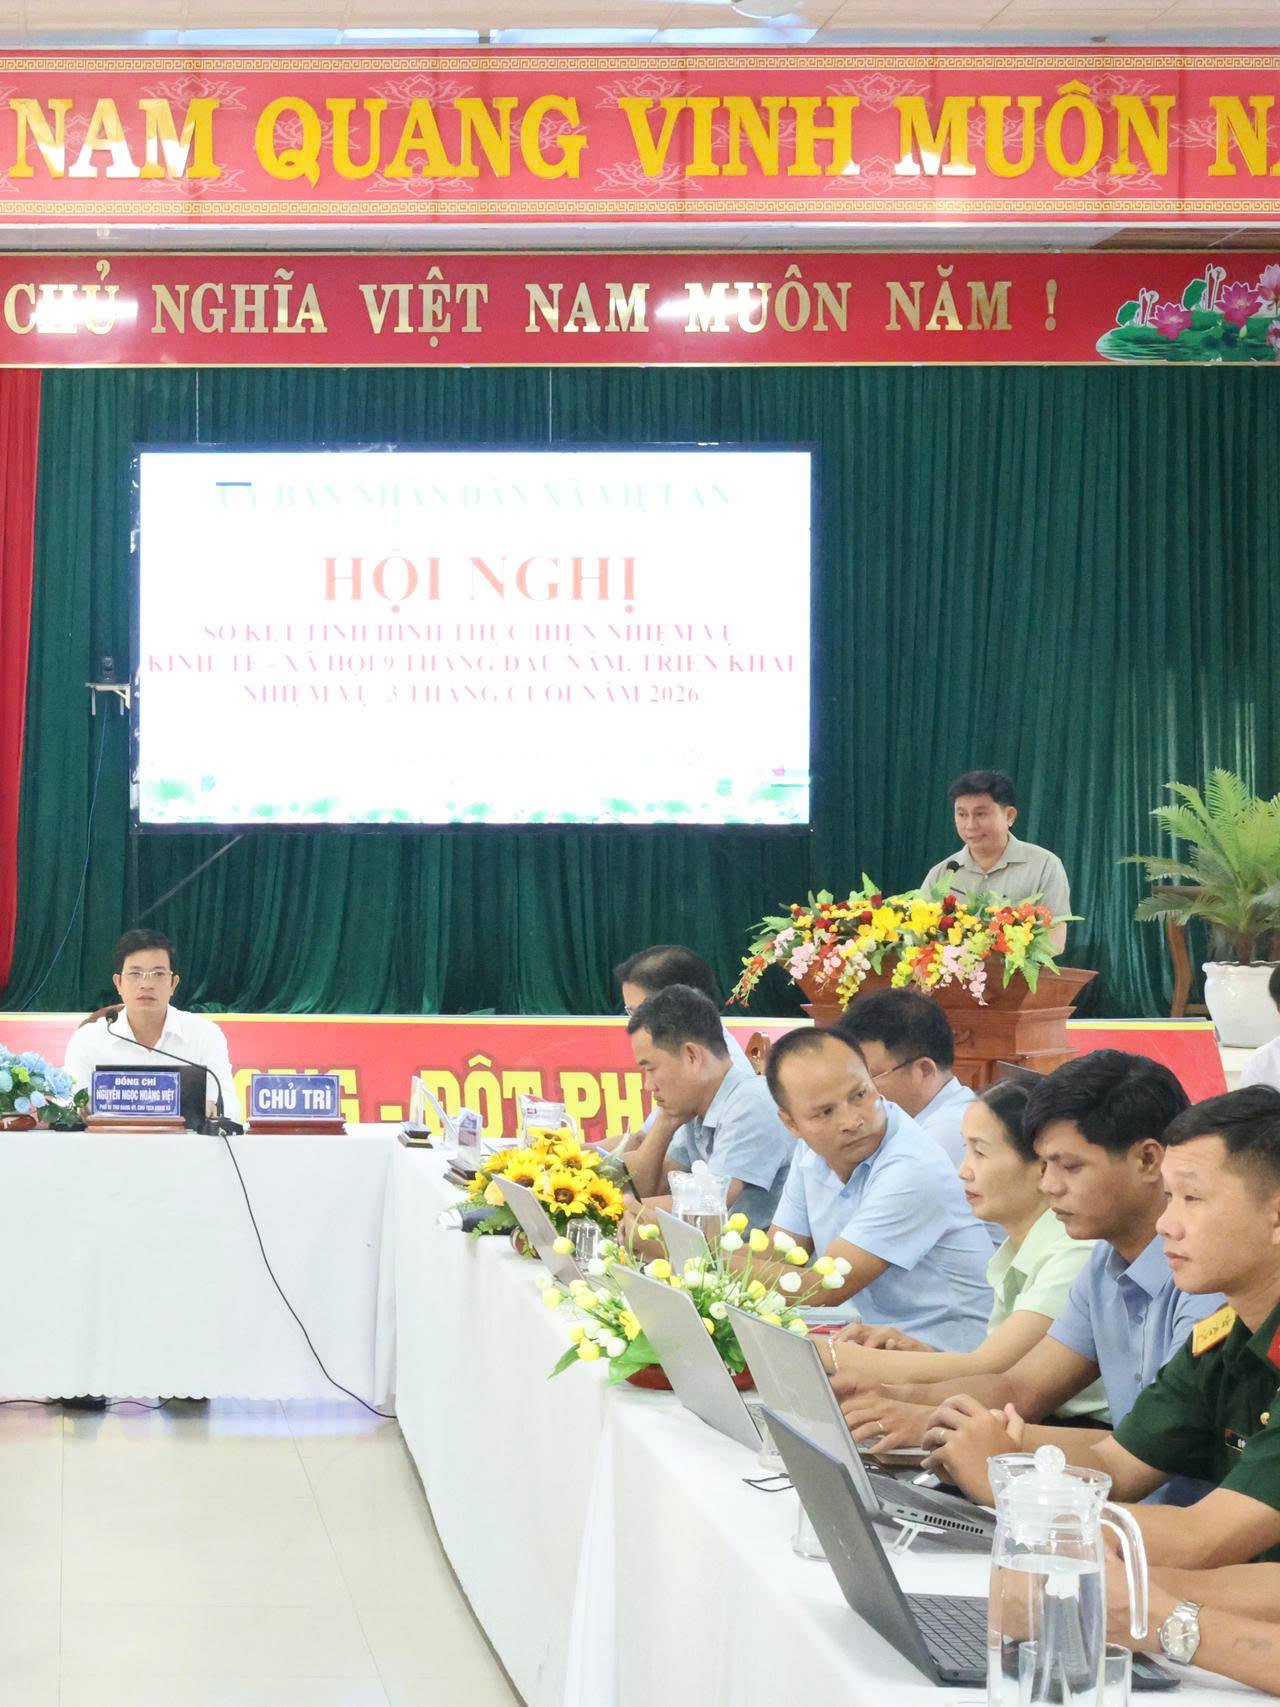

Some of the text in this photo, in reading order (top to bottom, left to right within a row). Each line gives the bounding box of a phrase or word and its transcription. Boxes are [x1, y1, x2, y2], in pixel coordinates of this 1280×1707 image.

[9, 97, 220, 179] NAM
[255, 95, 587, 187] QUANG
[618, 95, 860, 178] VINH
[893, 79, 1175, 178] MUÔN
[1208, 96, 1280, 177] N
[4, 259, 120, 334] CHỦ
[151, 268, 327, 333] NGHĨA
[359, 267, 488, 347] VIỆT
[525, 283, 650, 333] NAM
[684, 265, 851, 333] MUÔN
[886, 266, 1012, 331] NĂM
[468, 555, 636, 614] NGHỊ
[259, 1082, 297, 1109] CHỦ
[302, 1085, 332, 1110] TRÌ
[560, 1072, 658, 1142] PH
